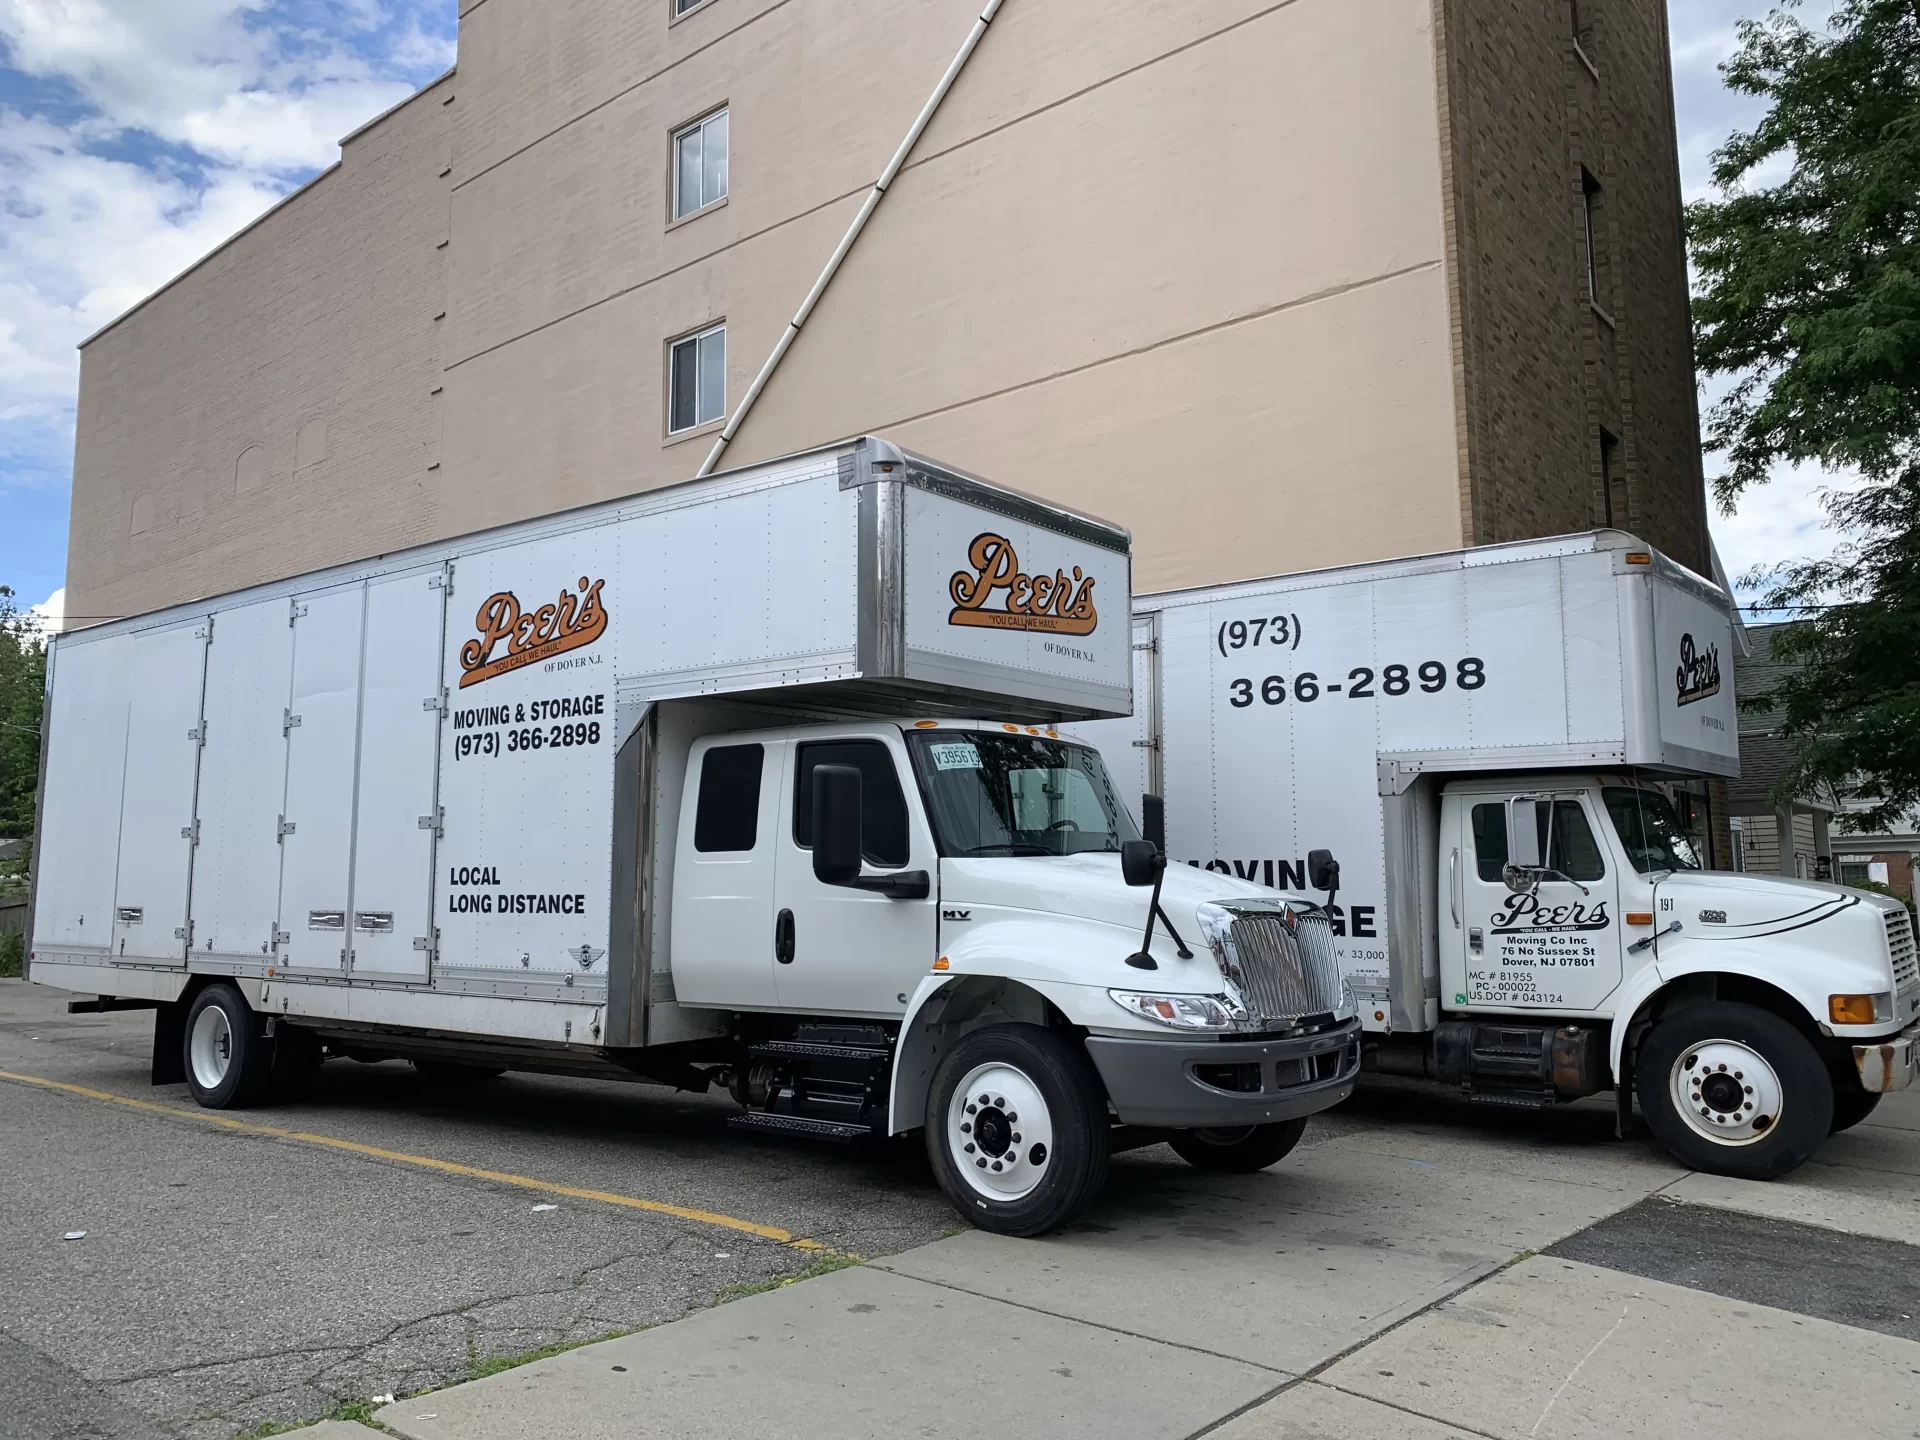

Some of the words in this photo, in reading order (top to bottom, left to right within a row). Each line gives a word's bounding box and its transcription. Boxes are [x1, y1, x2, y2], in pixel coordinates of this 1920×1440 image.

[949, 532, 1096, 619] Peer's
[460, 576, 608, 671] Peer's
[1026, 619, 1037, 628] WE
[1218, 613, 1301, 657] (973)
[510, 656, 526, 667] CALL
[528, 650, 539, 660] WE
[1044, 642, 1055, 653] OF
[1056, 645, 1081, 659] DOVER
[544, 663, 556, 673] OF
[557, 657, 586, 670] DOVER
[1229, 657, 1486, 708] 366-2898
[453, 705, 510, 730] MOVING
[515, 703, 525, 723] &
[530, 694, 604, 721] STORAGE
[455, 731, 500, 761] (973)
[507, 721, 600, 752] 366-2898
[934, 751, 980, 765] V395613
[450, 867, 500, 885] LOCAL
[449, 894, 492, 913] LONG
[498, 894, 585, 914] DISTANCE
[1660, 898, 1674, 911] 191
[1507, 936, 1546, 946] Moving
[1569, 936, 1588, 944] Inc
[1352, 950, 1384, 960] 33,000
[1501, 947, 1514, 955] 76
[1518, 947, 1533, 955] No
[1537, 947, 1579, 955] Sussex
[1583, 947, 1595, 955] St
[1502, 958, 1537, 967] Dover,
[1540, 958, 1556, 966] NJ
[1560, 958, 1595, 966] 07801
[1469, 971, 1485, 980] MC
[1489, 972, 1496, 980] #
[1500, 972, 1533, 981] 81955
[1476, 982, 1489, 991] PC
[1498, 982, 1536, 992] 000022
[1511, 993, 1519, 1001] #
[1522, 993, 1563, 1003] 043124
